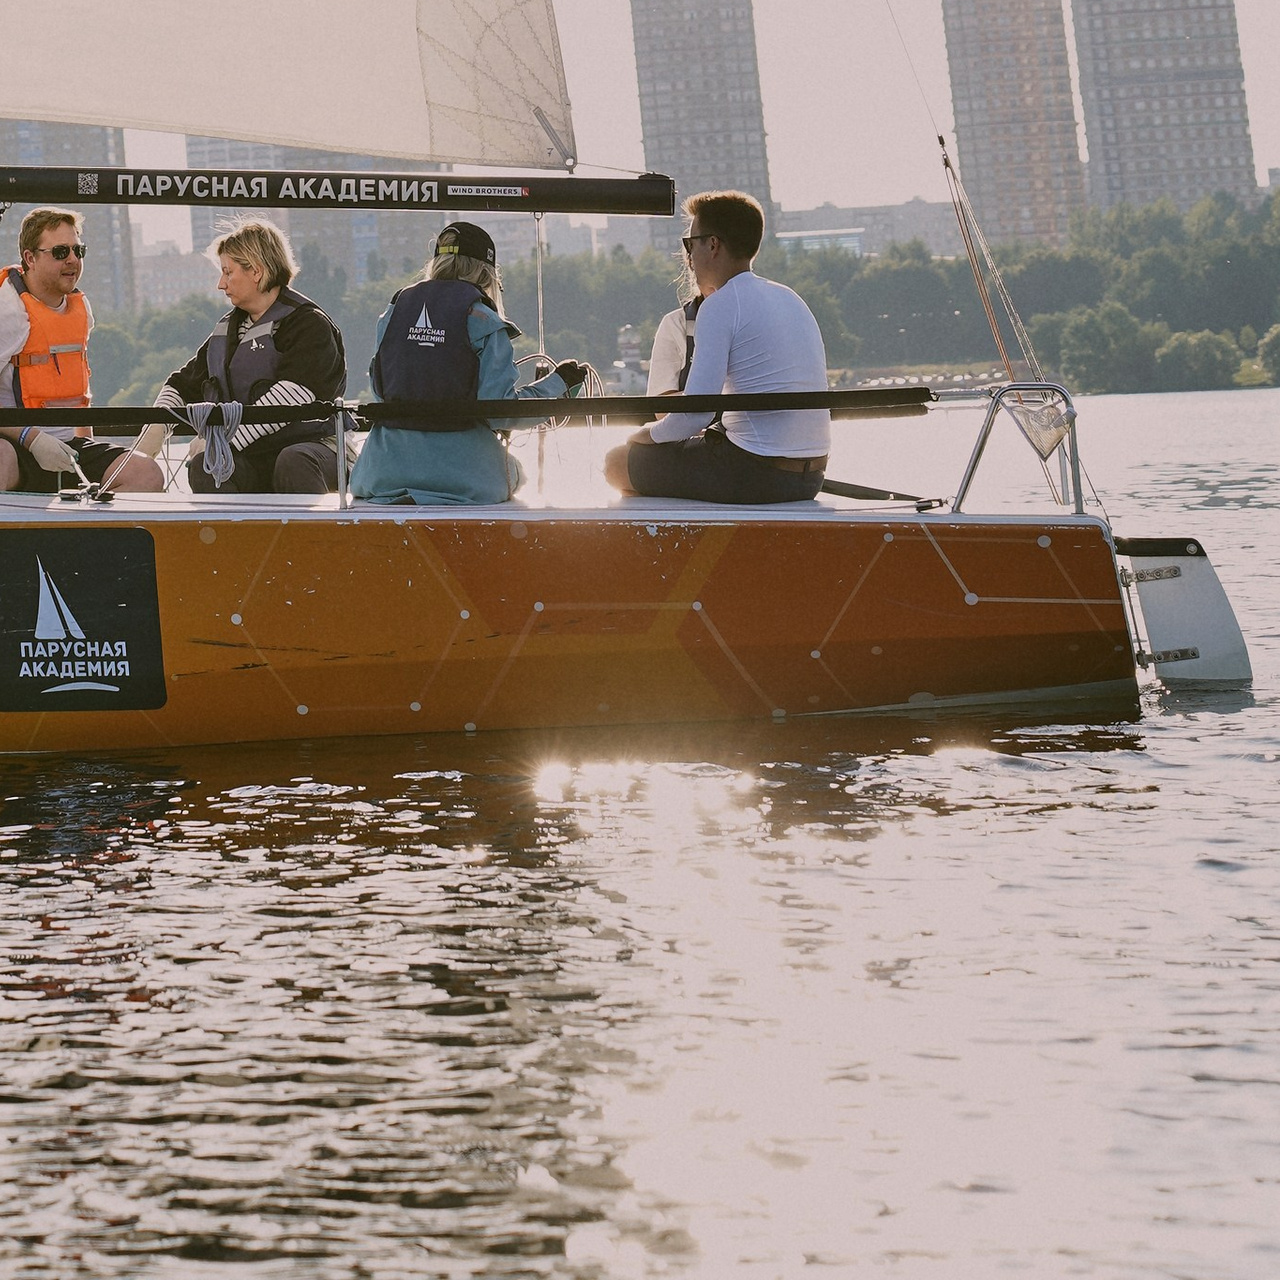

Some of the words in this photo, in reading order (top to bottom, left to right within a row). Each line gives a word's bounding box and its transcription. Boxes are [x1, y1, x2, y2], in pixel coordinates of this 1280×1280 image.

[117, 174, 268, 198] ПАРУСНАЯ
[278, 177, 439, 203] АКАДЕМИЯ
[407, 333, 445, 343] АКАДЕМИЯ
[409, 327, 446, 337] ПАРУСНАЯ
[20, 641, 128, 658] ПАРУСНАЯ
[19, 660, 130, 679] АКАДЕМИЯ
